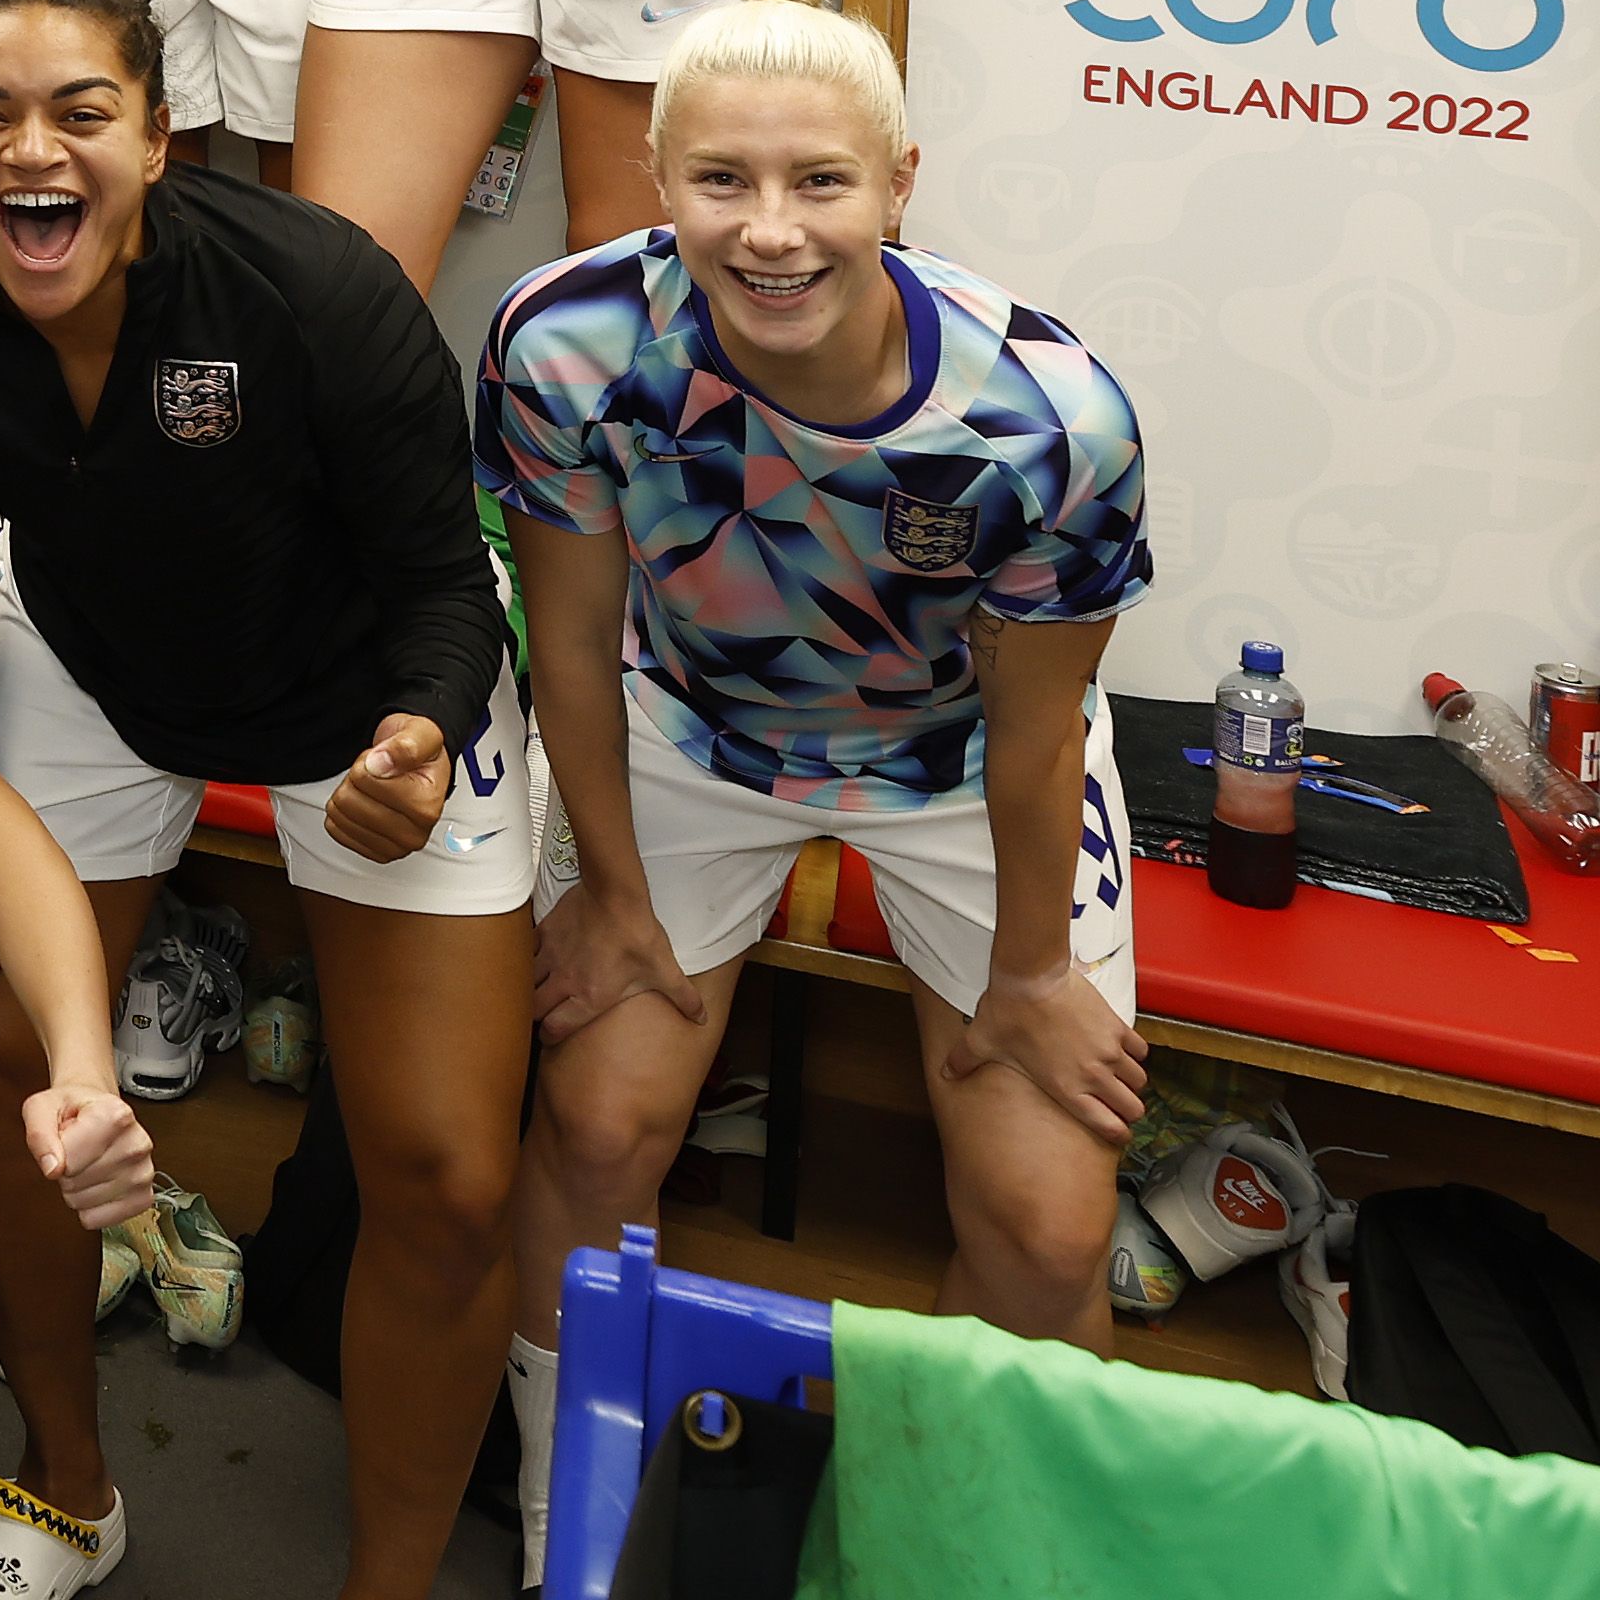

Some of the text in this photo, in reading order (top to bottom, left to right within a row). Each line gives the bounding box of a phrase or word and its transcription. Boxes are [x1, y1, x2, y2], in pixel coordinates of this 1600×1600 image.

[1083, 64, 1531, 141] ENGLAND 2022
[1237, 1179, 1268, 1206] NIKE
[1219, 1193, 1246, 1220] AIR
